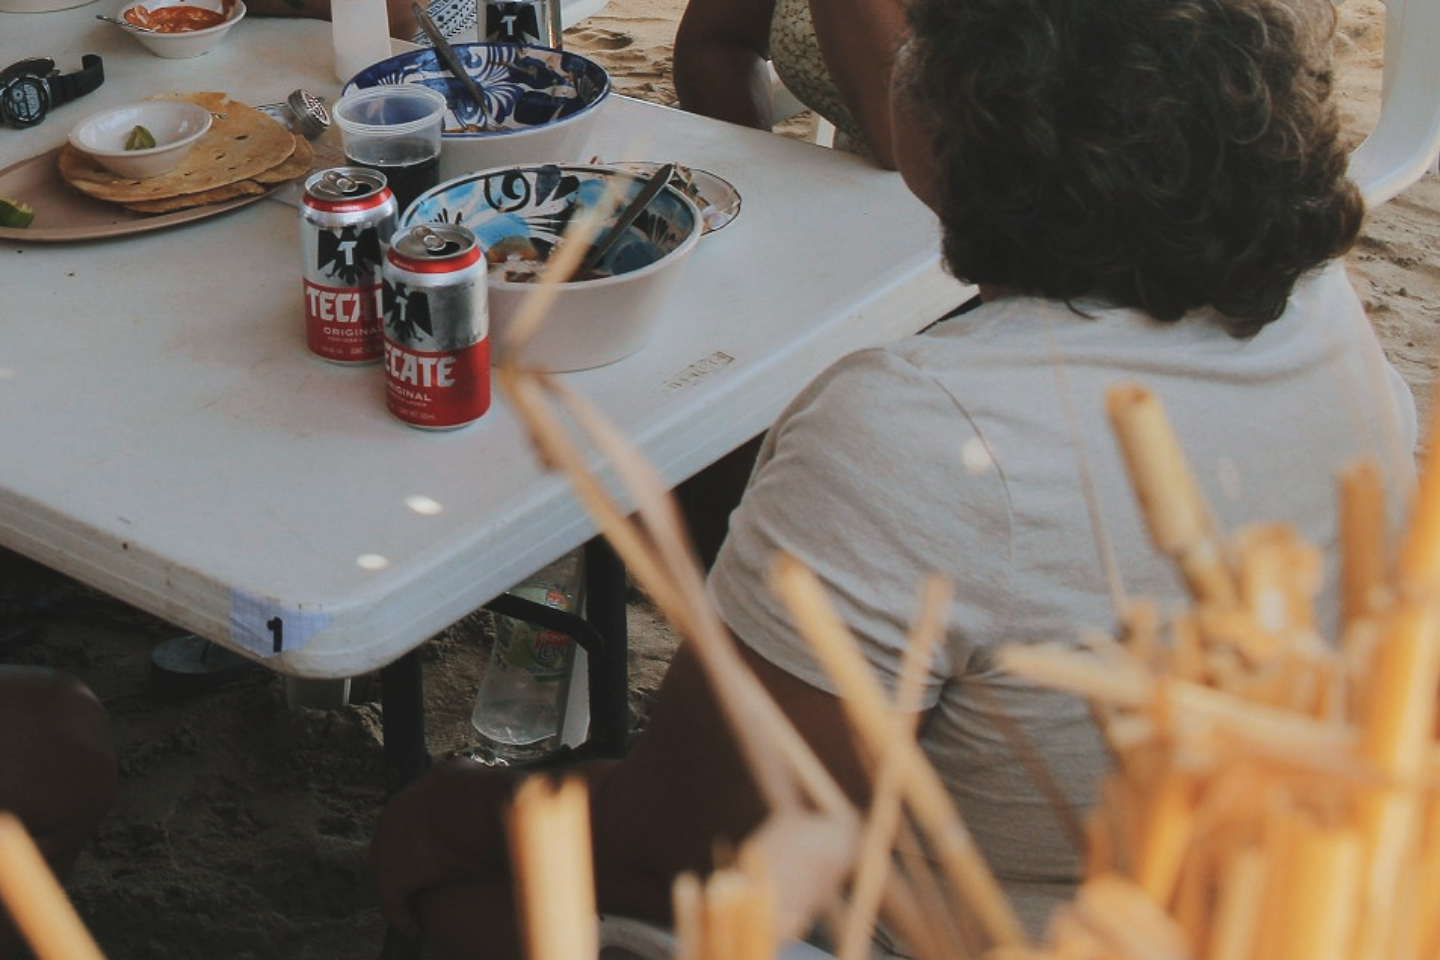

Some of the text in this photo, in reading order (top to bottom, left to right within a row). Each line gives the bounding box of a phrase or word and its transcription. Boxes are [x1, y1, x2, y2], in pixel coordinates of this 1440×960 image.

[501, 15, 517, 36] T
[337, 241, 357, 265] T
[396, 296, 408, 321] T
[385, 341, 457, 387] ECATE
[266, 616, 283, 653] 1
